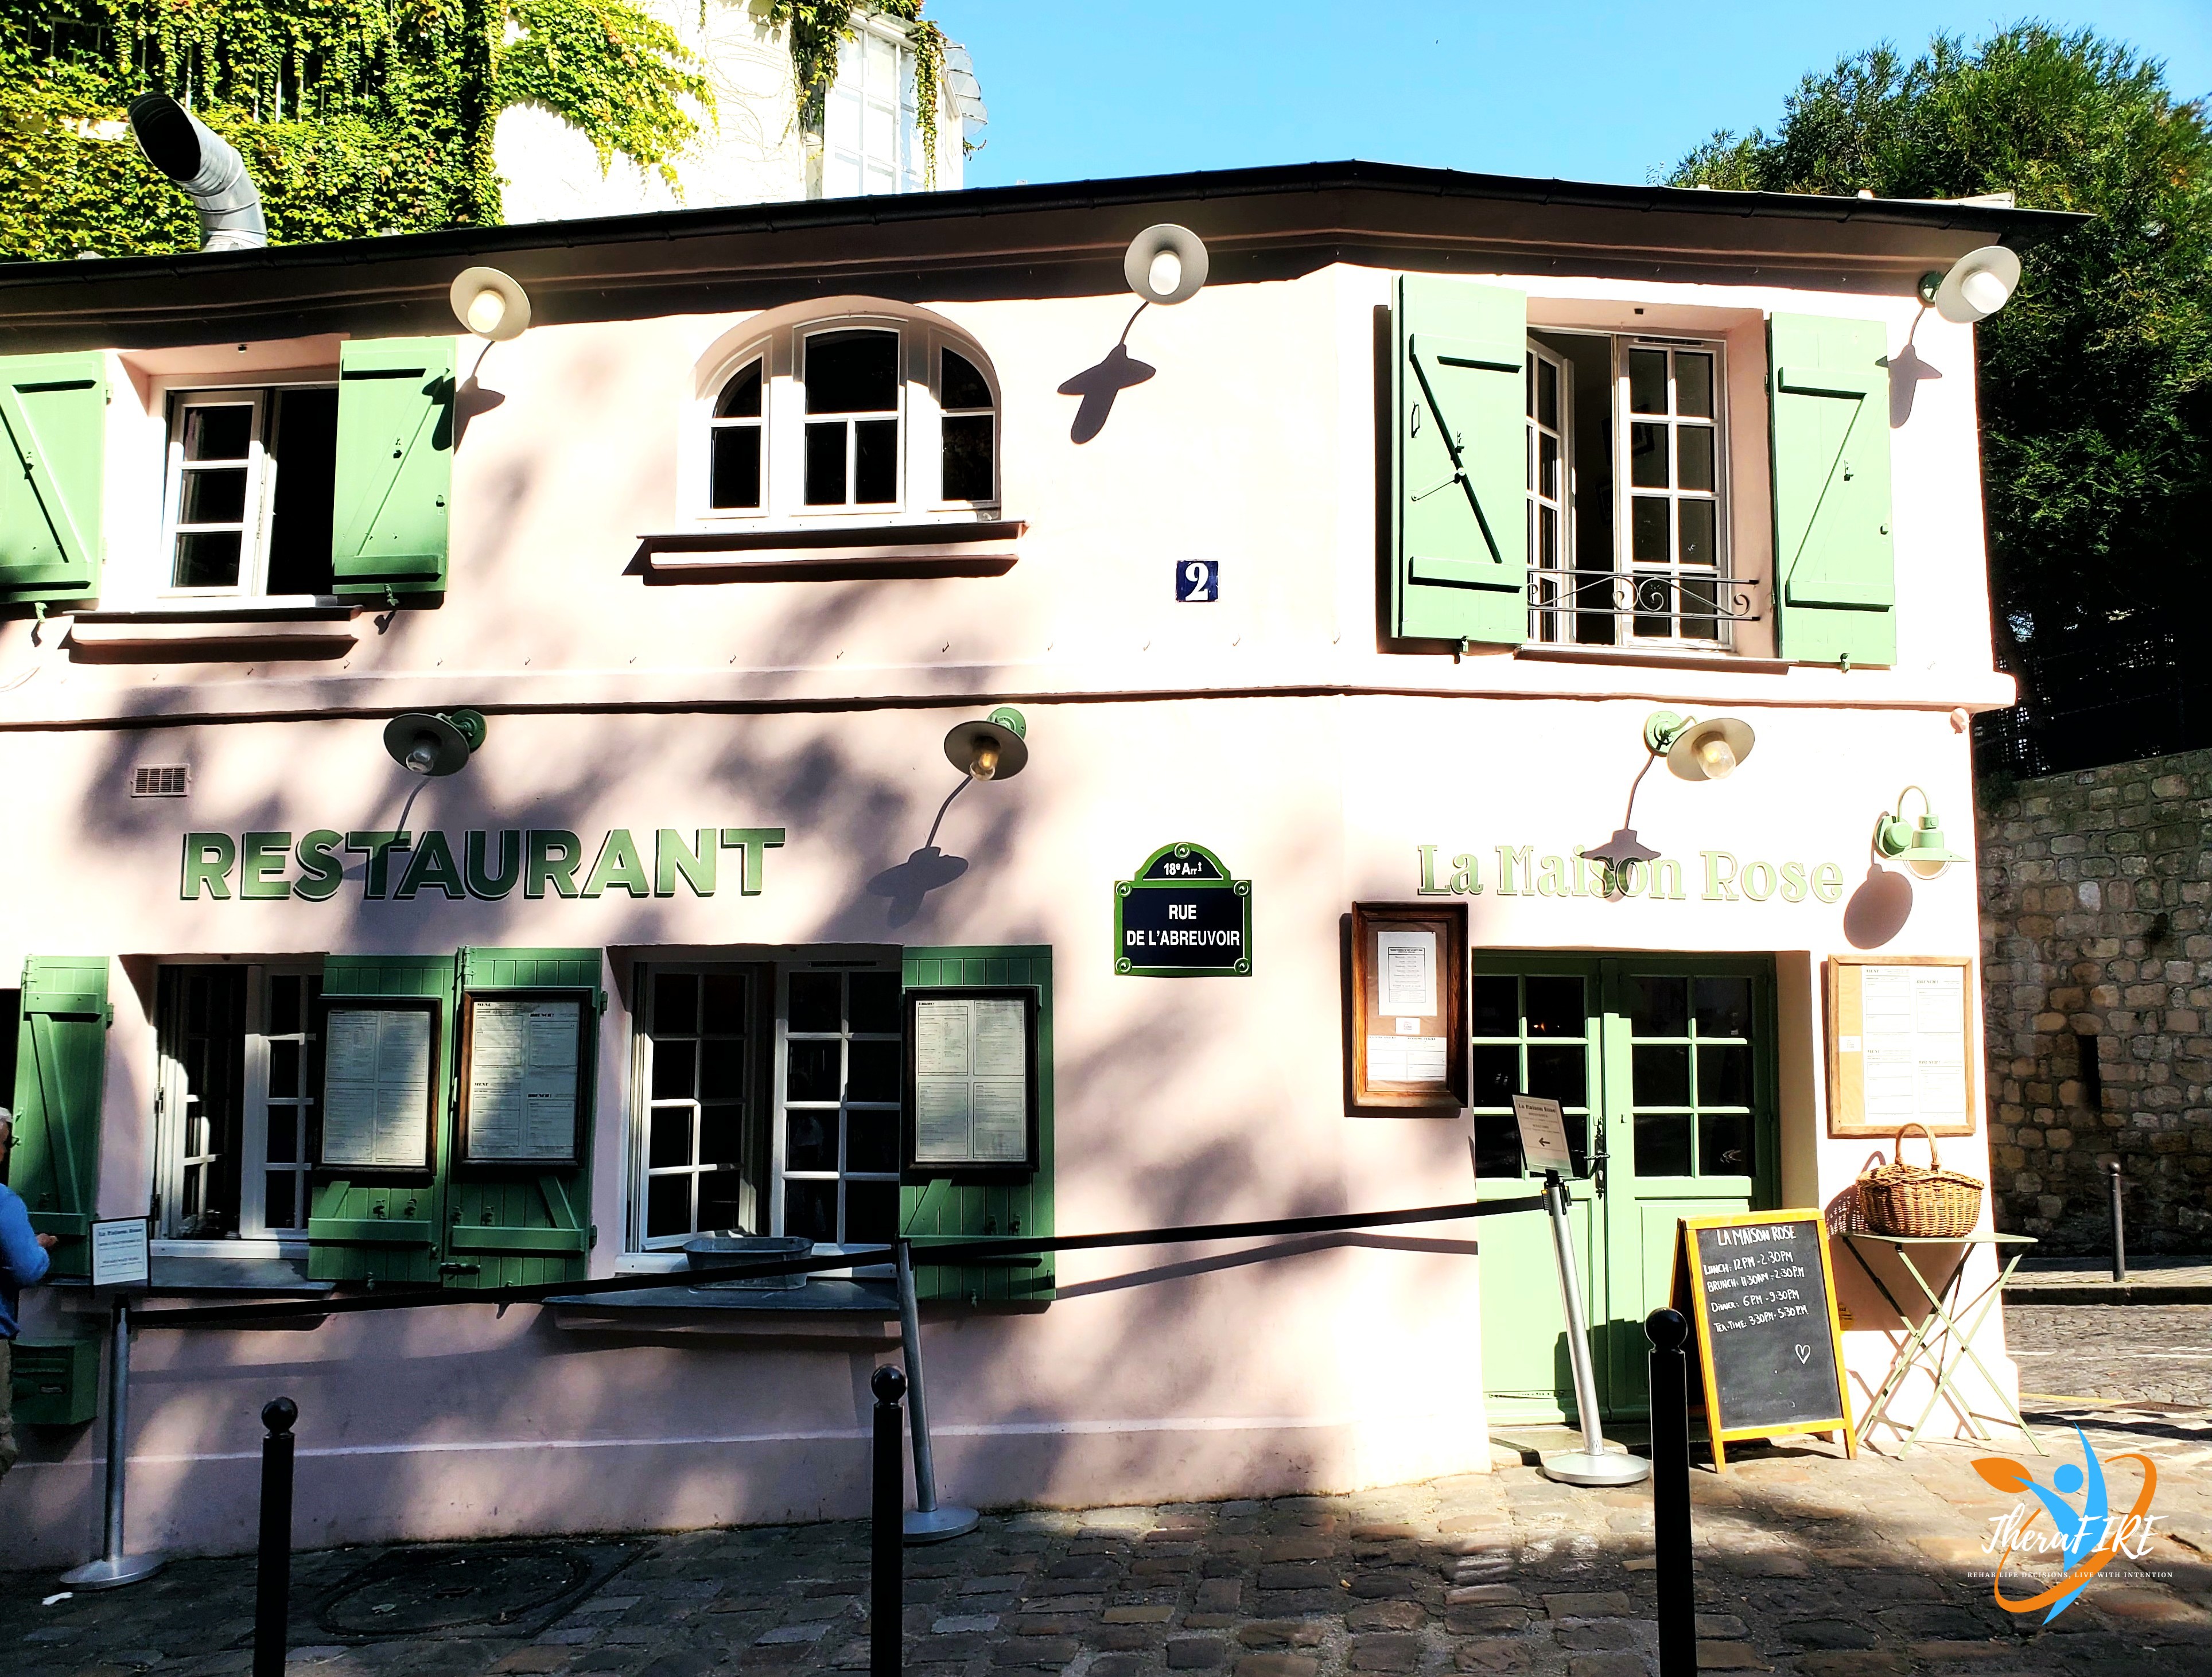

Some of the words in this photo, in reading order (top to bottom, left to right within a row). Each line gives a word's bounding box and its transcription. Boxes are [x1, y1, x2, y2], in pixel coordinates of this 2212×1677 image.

[1185, 562, 1209, 601] 2
[180, 828, 786, 902] RESTAURANT
[1417, 845, 1484, 896] La
[1496, 845, 1686, 900] Maison
[1700, 850, 1844, 904] Rose
[1169, 904, 1197, 920] RUE
[1126, 930, 1145, 946] DE
[1148, 930, 1241, 946] L'ABREUVOIR
[1716, 1229, 1732, 1246] LA
[1771, 1225, 1797, 1242] ROSE
[1703, 1263, 1732, 1275] LUNCH:
[1706, 1278, 1739, 1293] BRUNCH:
